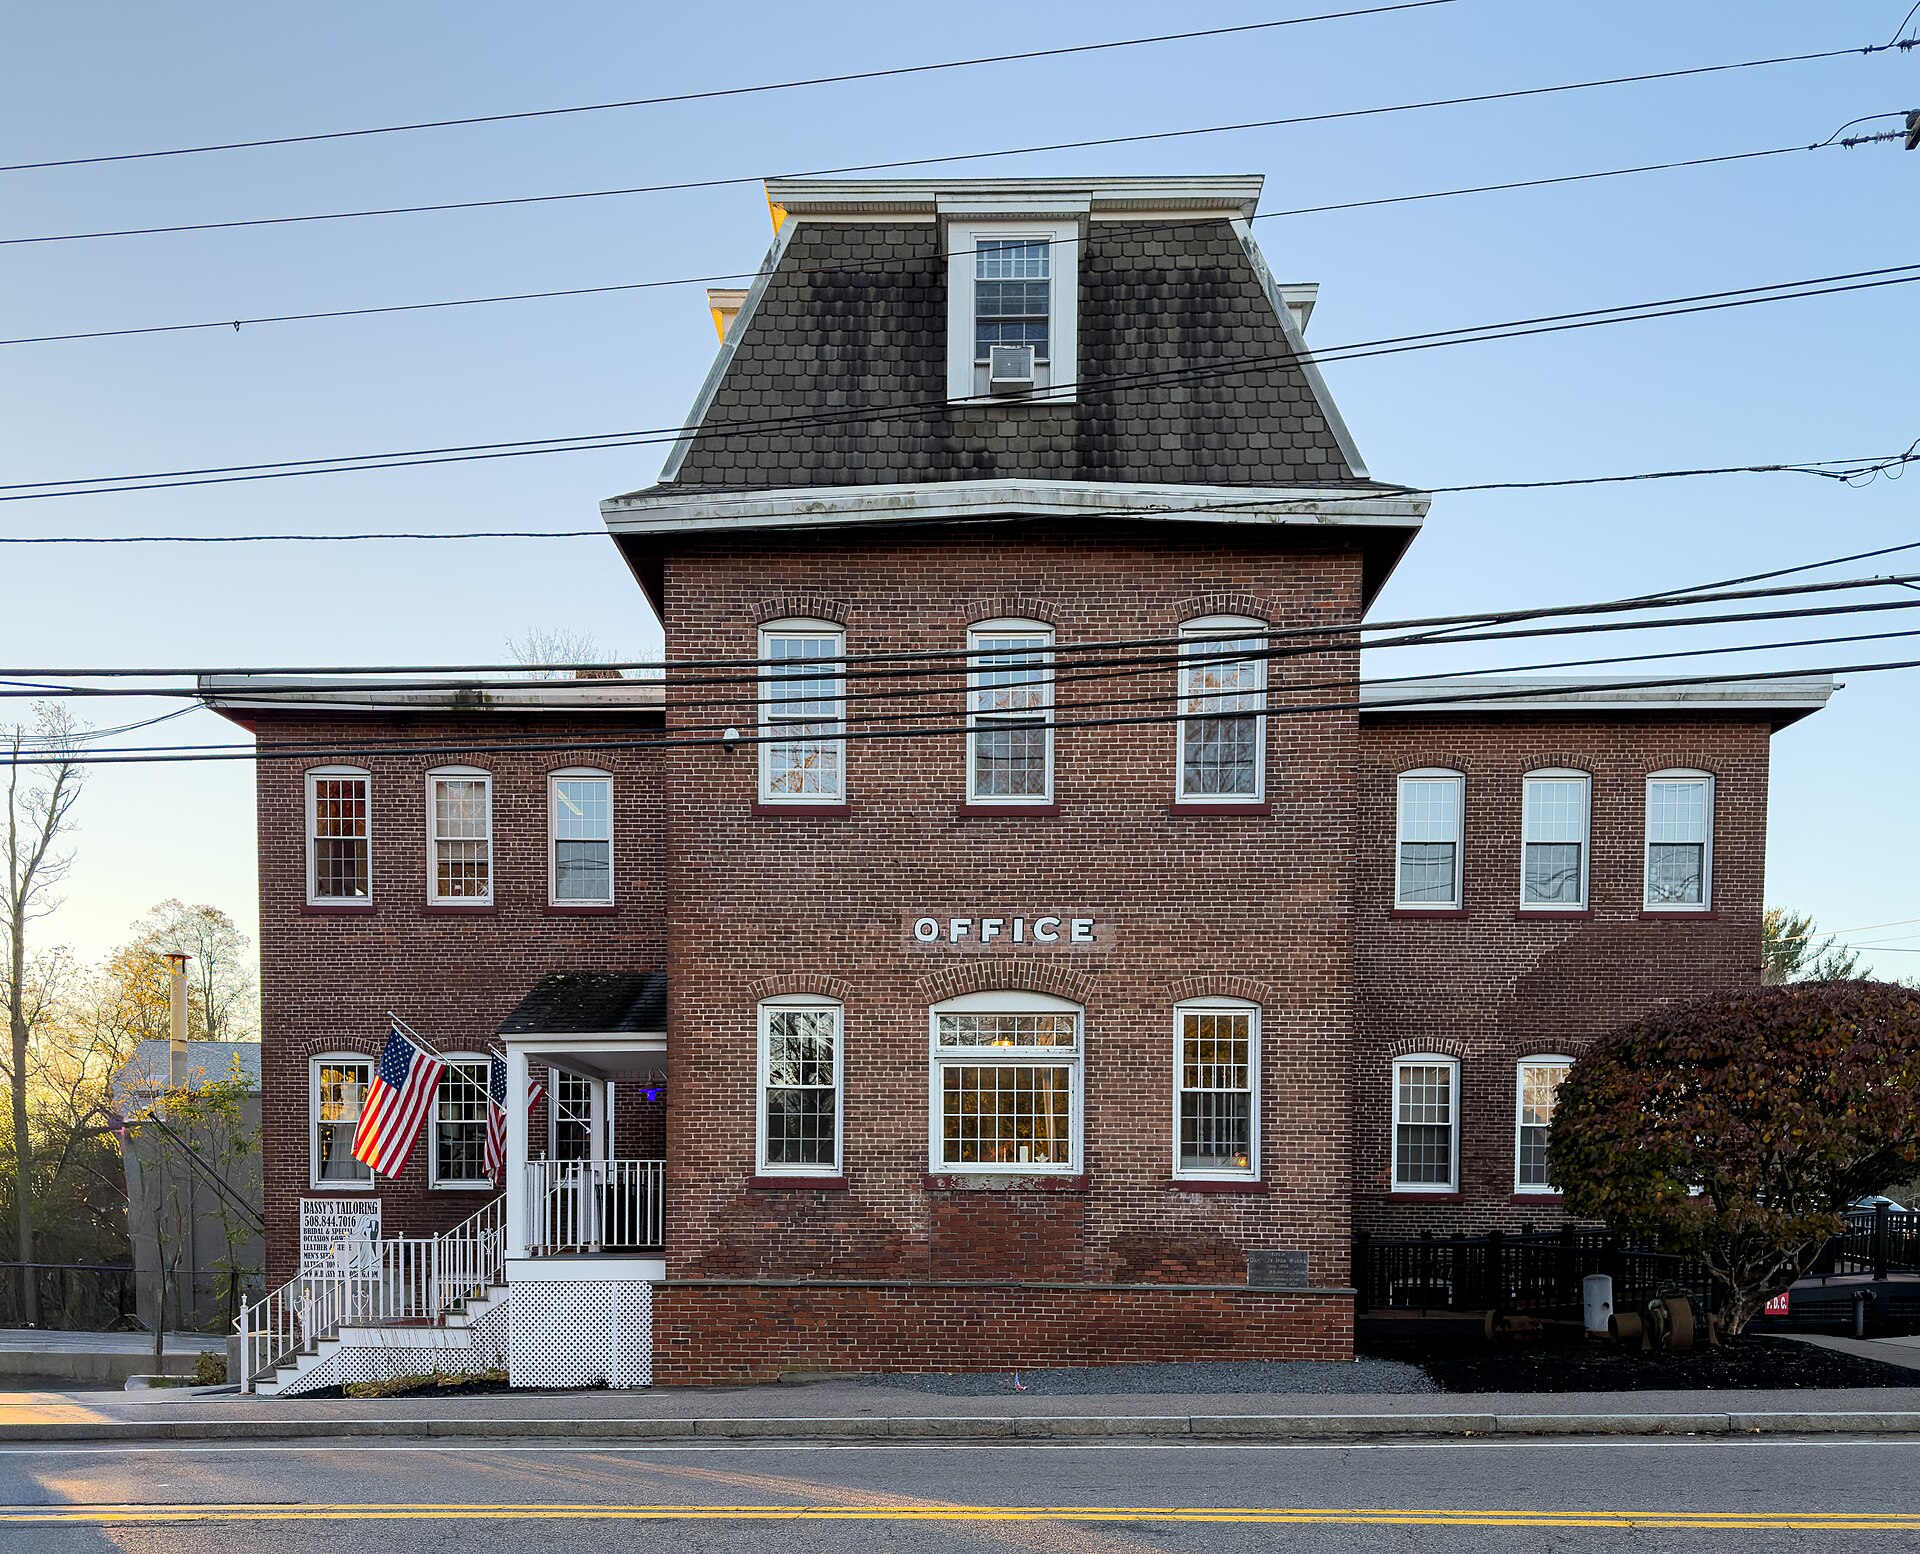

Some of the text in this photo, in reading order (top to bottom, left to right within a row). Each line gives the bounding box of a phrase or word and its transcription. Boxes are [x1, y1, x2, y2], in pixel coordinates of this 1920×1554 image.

[913, 916, 1097, 943] OFFICE
[303, 1201, 378, 1215] BASSY'S TAILORING
[304, 1215, 356, 1227] 508.844.7016
